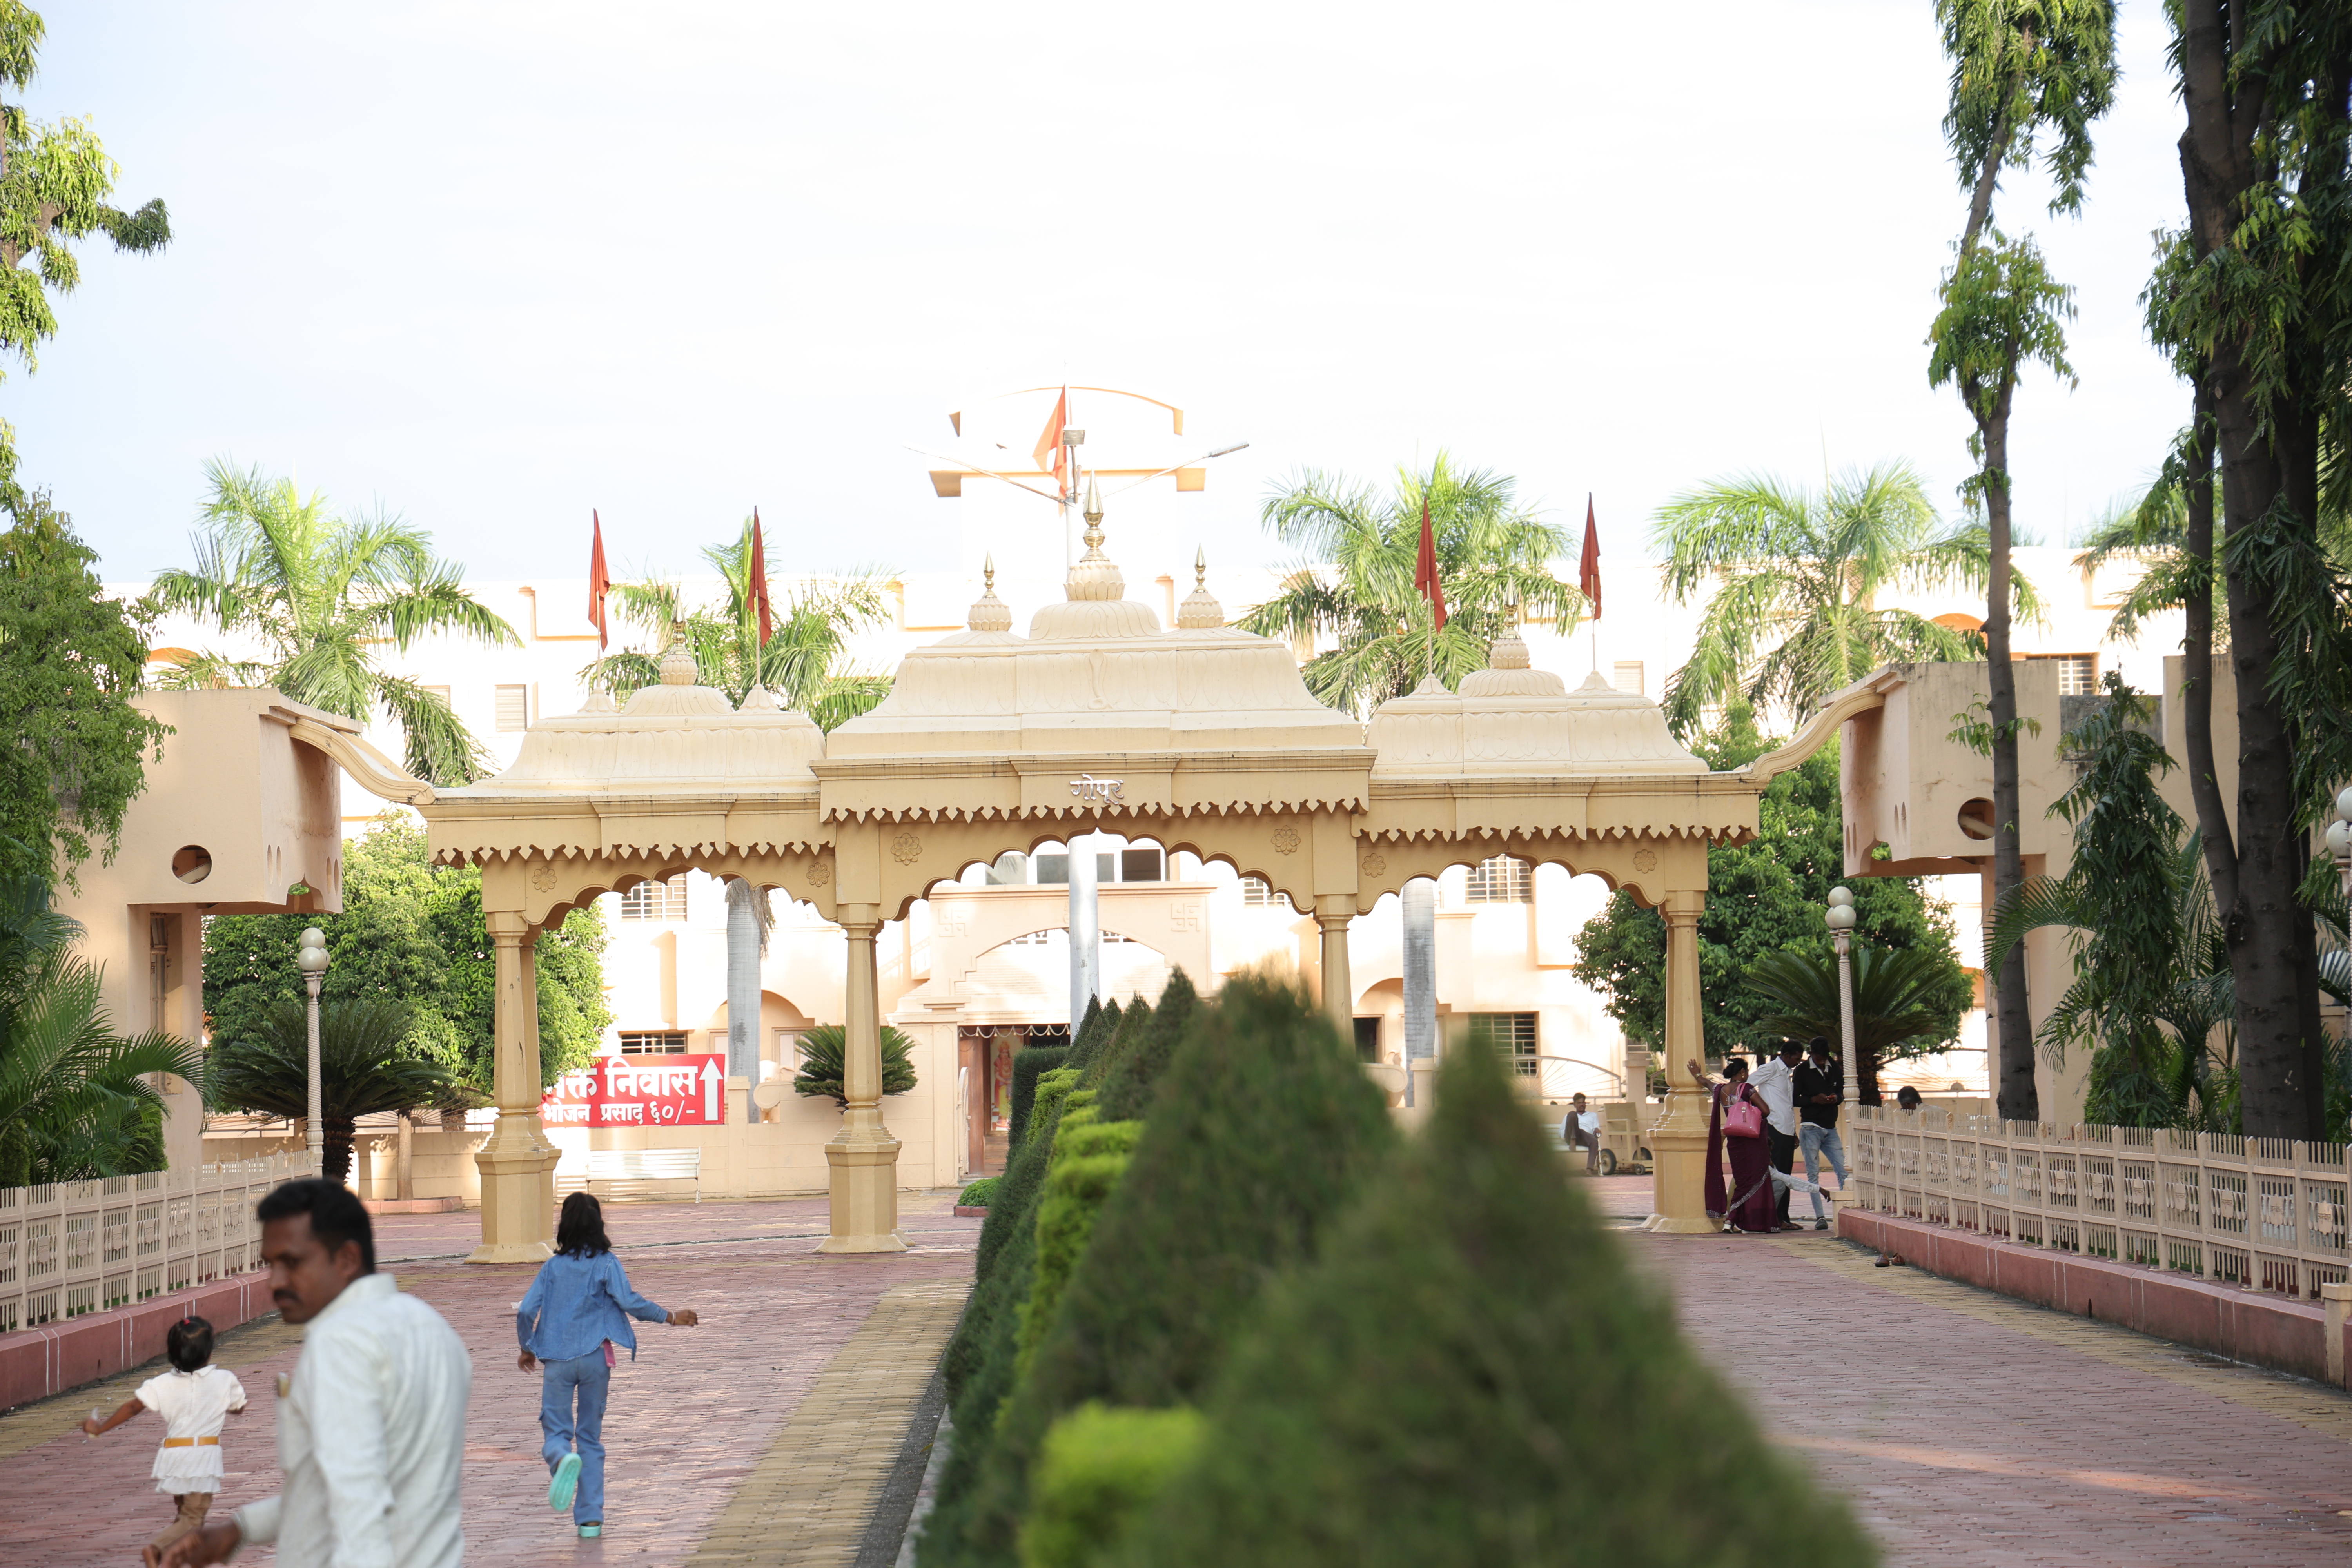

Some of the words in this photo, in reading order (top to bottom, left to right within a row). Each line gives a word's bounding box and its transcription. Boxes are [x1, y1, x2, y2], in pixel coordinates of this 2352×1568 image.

[1069, 774, 1124, 805] गोपूर
[604, 1056, 698, 1098] निवास
[543, 1098, 591, 1123] भोजन
[600, 1103, 644, 1125] प्रसाद
